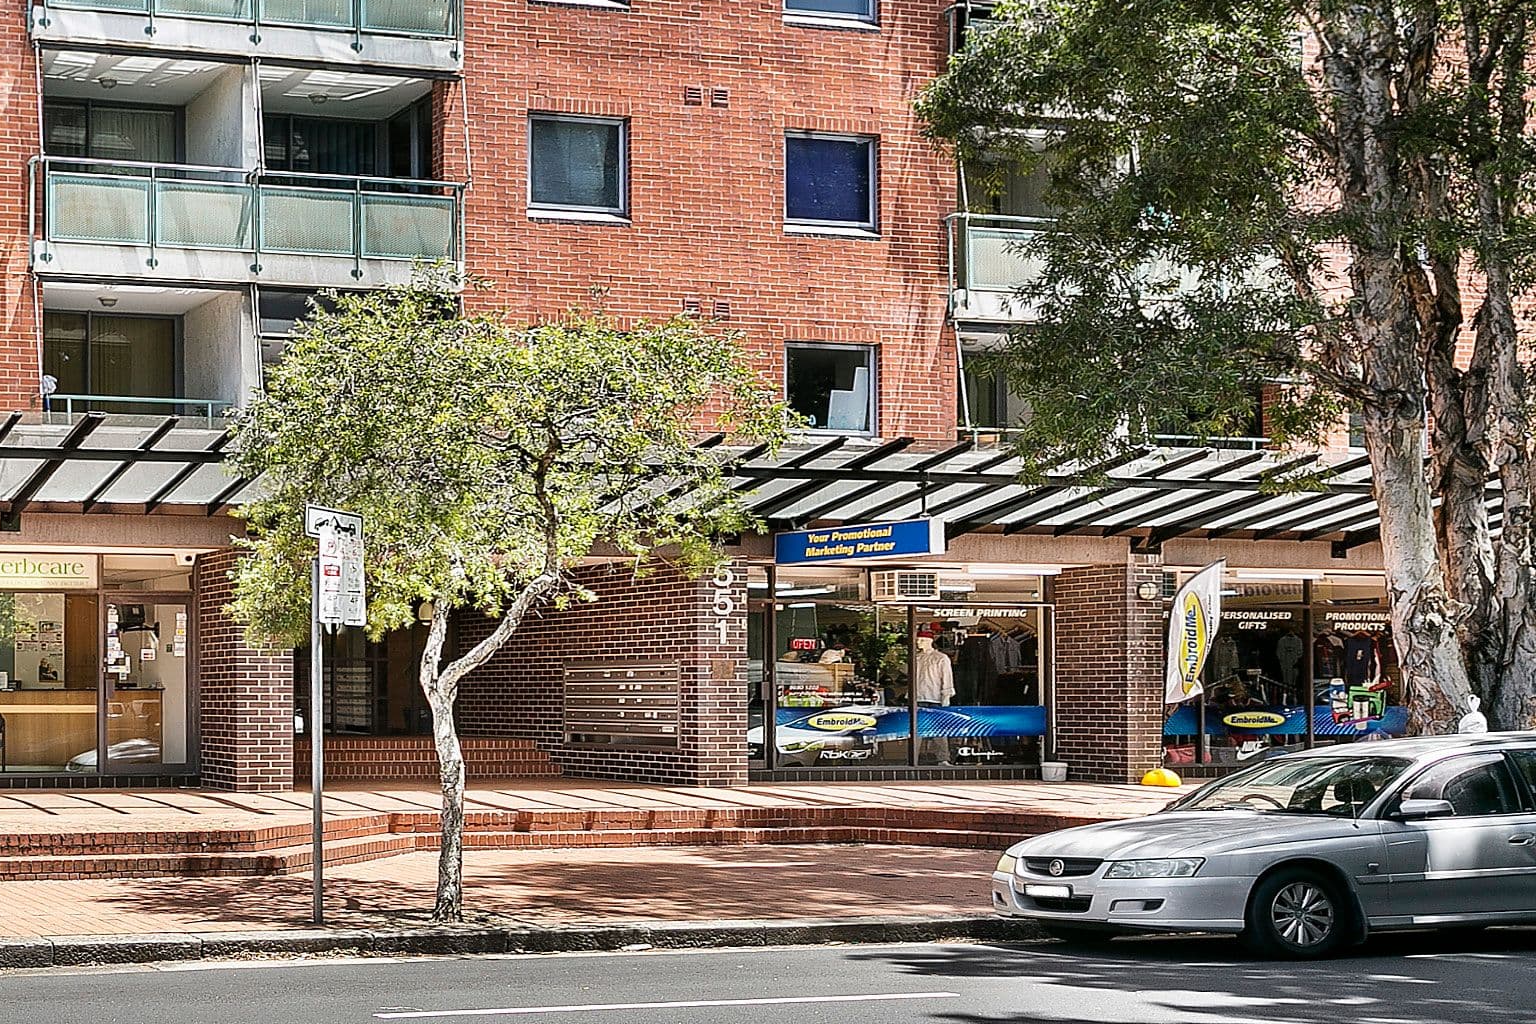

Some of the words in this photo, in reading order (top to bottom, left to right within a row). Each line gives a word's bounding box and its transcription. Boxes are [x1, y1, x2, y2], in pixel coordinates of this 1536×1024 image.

[808, 533, 830, 543] Your
[831, 526, 892, 541] Promotional
[805, 546, 854, 557] Marketing
[856, 541, 896, 553] Partner
[934, 609, 974, 617] SCREEN
[977, 609, 1027, 617] PRINTING
[1220, 611, 1292, 621] PERSONALISED
[1326, 612, 1391, 622] PROMOTIONA
[1238, 621, 1267, 631] GIFTS
[1334, 622, 1386, 632] PRODUCTS
[792, 638, 817, 649] OPEN
[1241, 741, 1264, 752] NIKE
